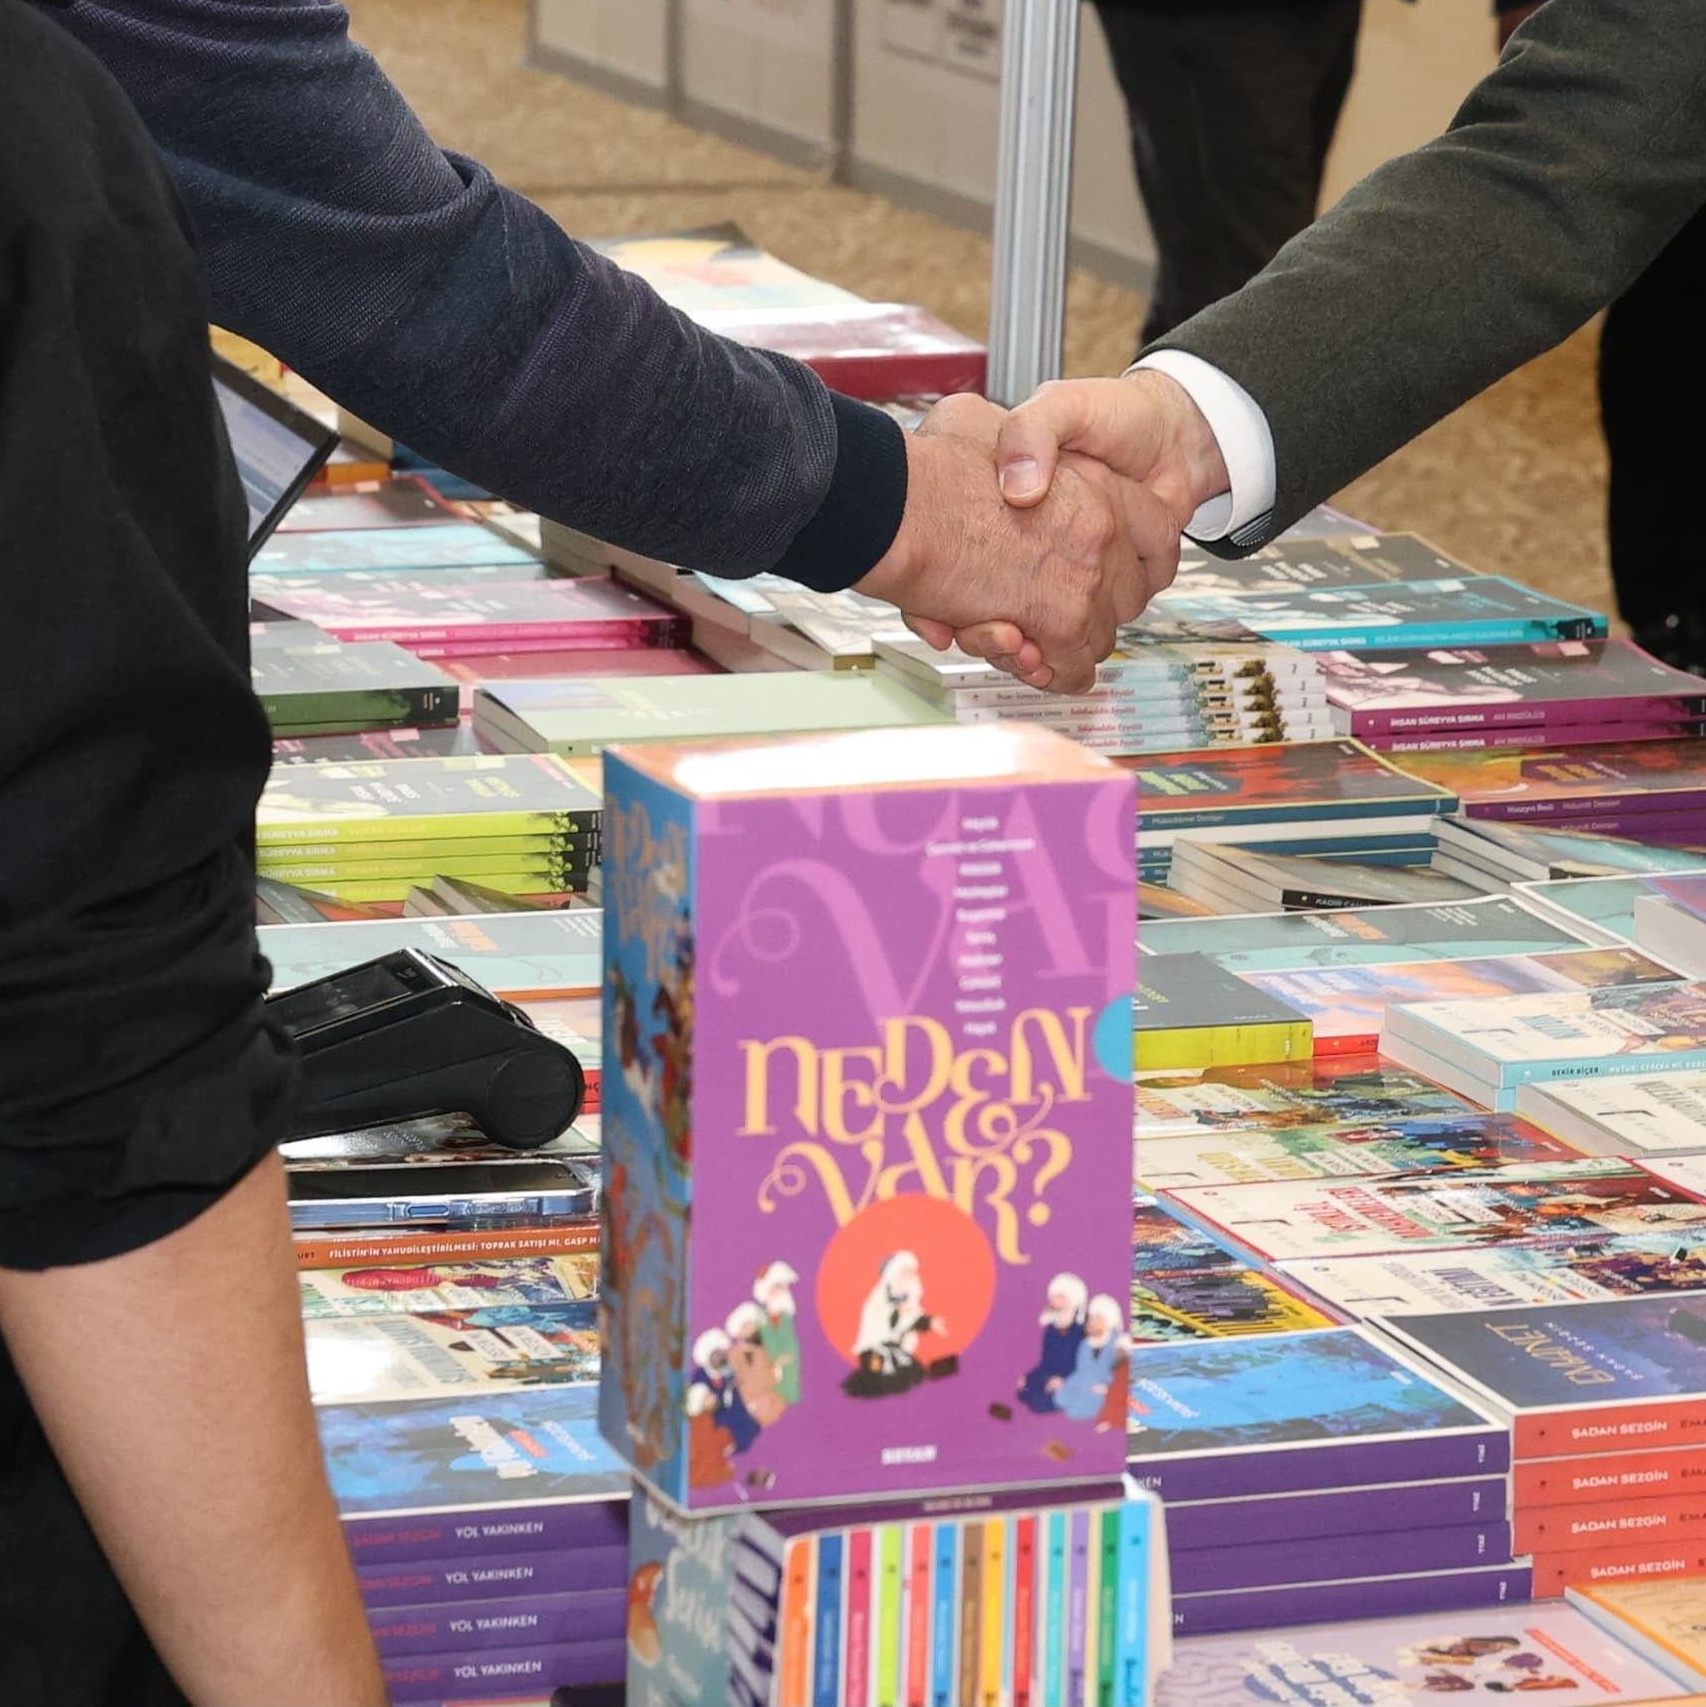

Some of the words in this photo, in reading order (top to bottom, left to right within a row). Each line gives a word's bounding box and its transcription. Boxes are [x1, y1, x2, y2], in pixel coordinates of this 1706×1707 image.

[480, 1239, 517, 1251] TOPRAK
[1620, 1419, 1668, 1433] SEZGİN
[1620, 1470, 1669, 1483] SEZGİN
[1619, 1515, 1667, 1528] SEZGİN
[455, 1525, 479, 1539] YOL
[482, 1521, 544, 1537] YAKINKEN
[1637, 1558, 1686, 1573] SEZGİN
[445, 1571, 469, 1584] YOL
[472, 1567, 534, 1582] YAKINKEN
[450, 1619, 473, 1632] YOL
[476, 1614, 538, 1630] YAKINKEN
[454, 1665, 478, 1678] YOL
[480, 1660, 542, 1677] YAKINKEN
